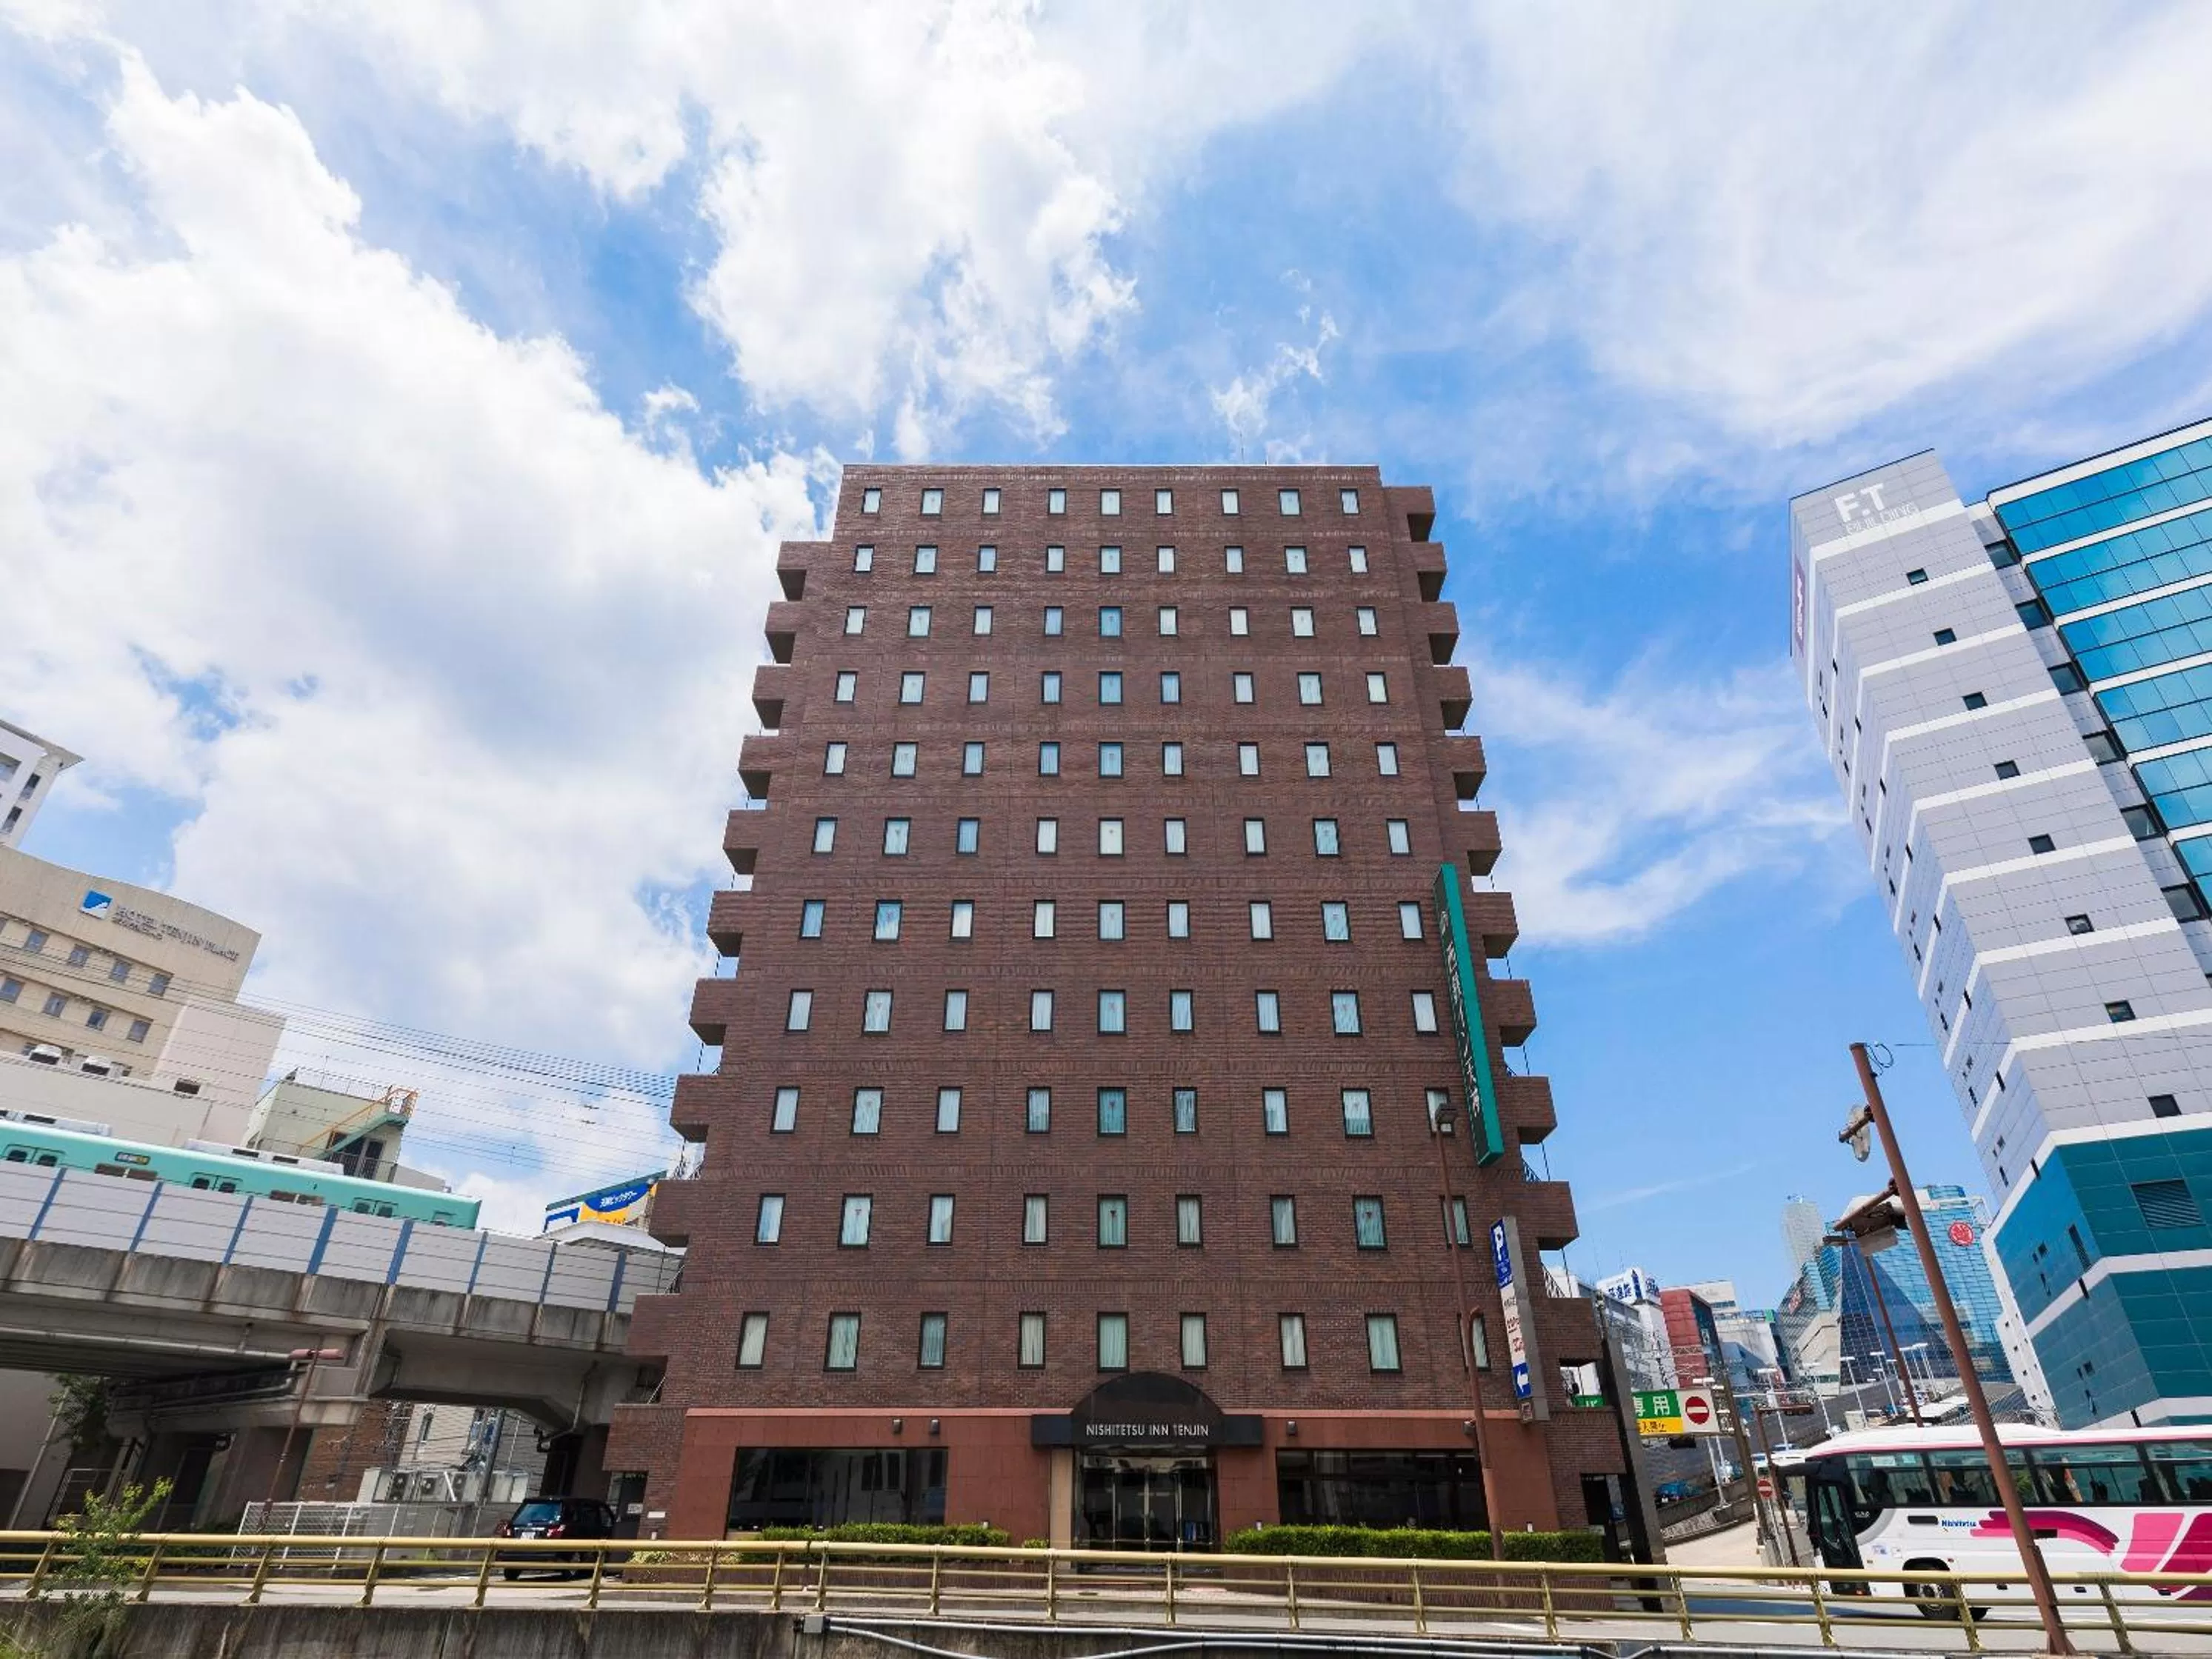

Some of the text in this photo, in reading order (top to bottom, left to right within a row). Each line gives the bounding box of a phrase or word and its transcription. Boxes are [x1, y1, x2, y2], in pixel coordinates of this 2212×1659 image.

[1493, 1225, 1504, 1261] P
[1086, 1423, 1209, 1436] NISHITETSU INN TENJIN
